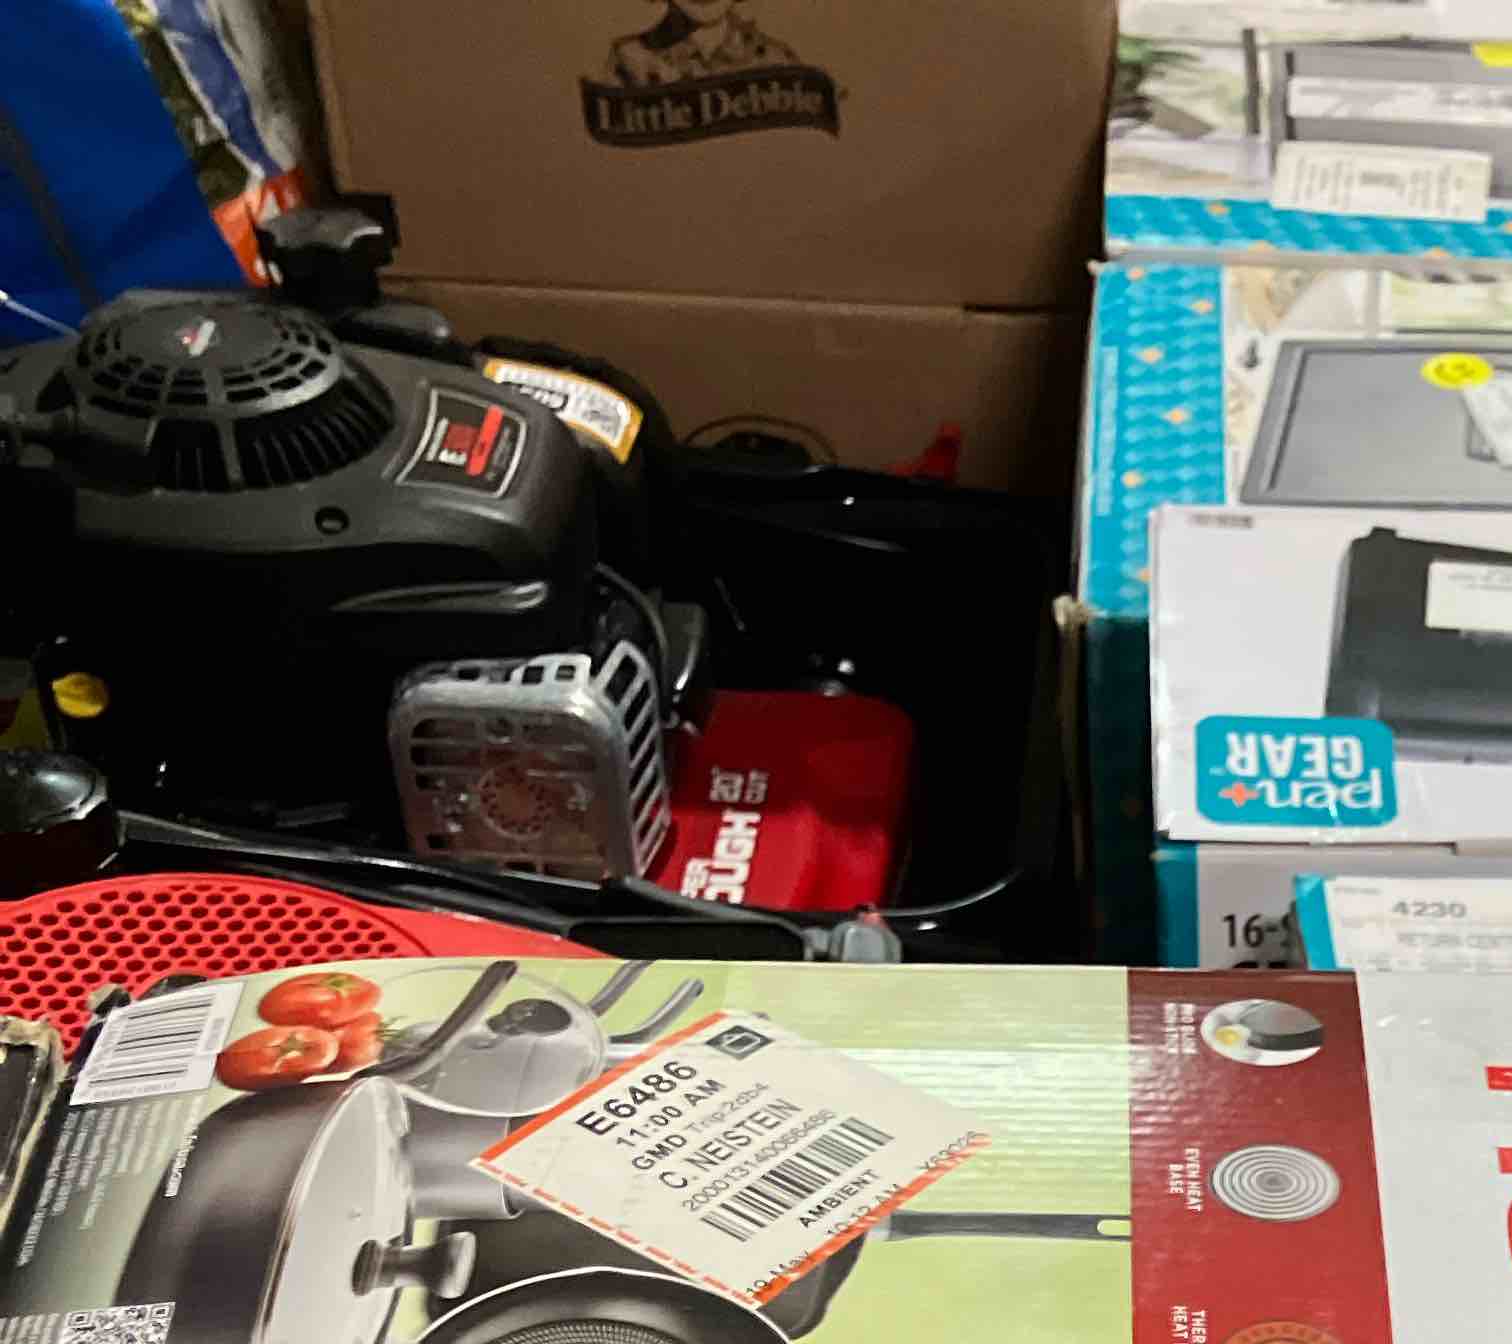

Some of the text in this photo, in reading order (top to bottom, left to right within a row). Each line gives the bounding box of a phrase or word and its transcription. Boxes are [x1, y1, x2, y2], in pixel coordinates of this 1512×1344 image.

[597, 82, 825, 133] Little Debbie
[1222, 735, 1364, 777] GEAR
[704, 808, 761, 905] OUGH
[1393, 900, 1466, 919] 4230
[576, 1061, 697, 1136] E6486
[616, 1079, 726, 1147] 11:00 AM
[632, 1134, 687, 1170] GMD
[658, 1098, 802, 1189] C. NEISTEIN
[799, 1169, 880, 1228] AMBIENT
[1168, 1164, 1184, 1195] BASE
[1185, 1147, 1202, 1212] EVEN HEAT
[1172, 1305, 1188, 1341] HEAT
